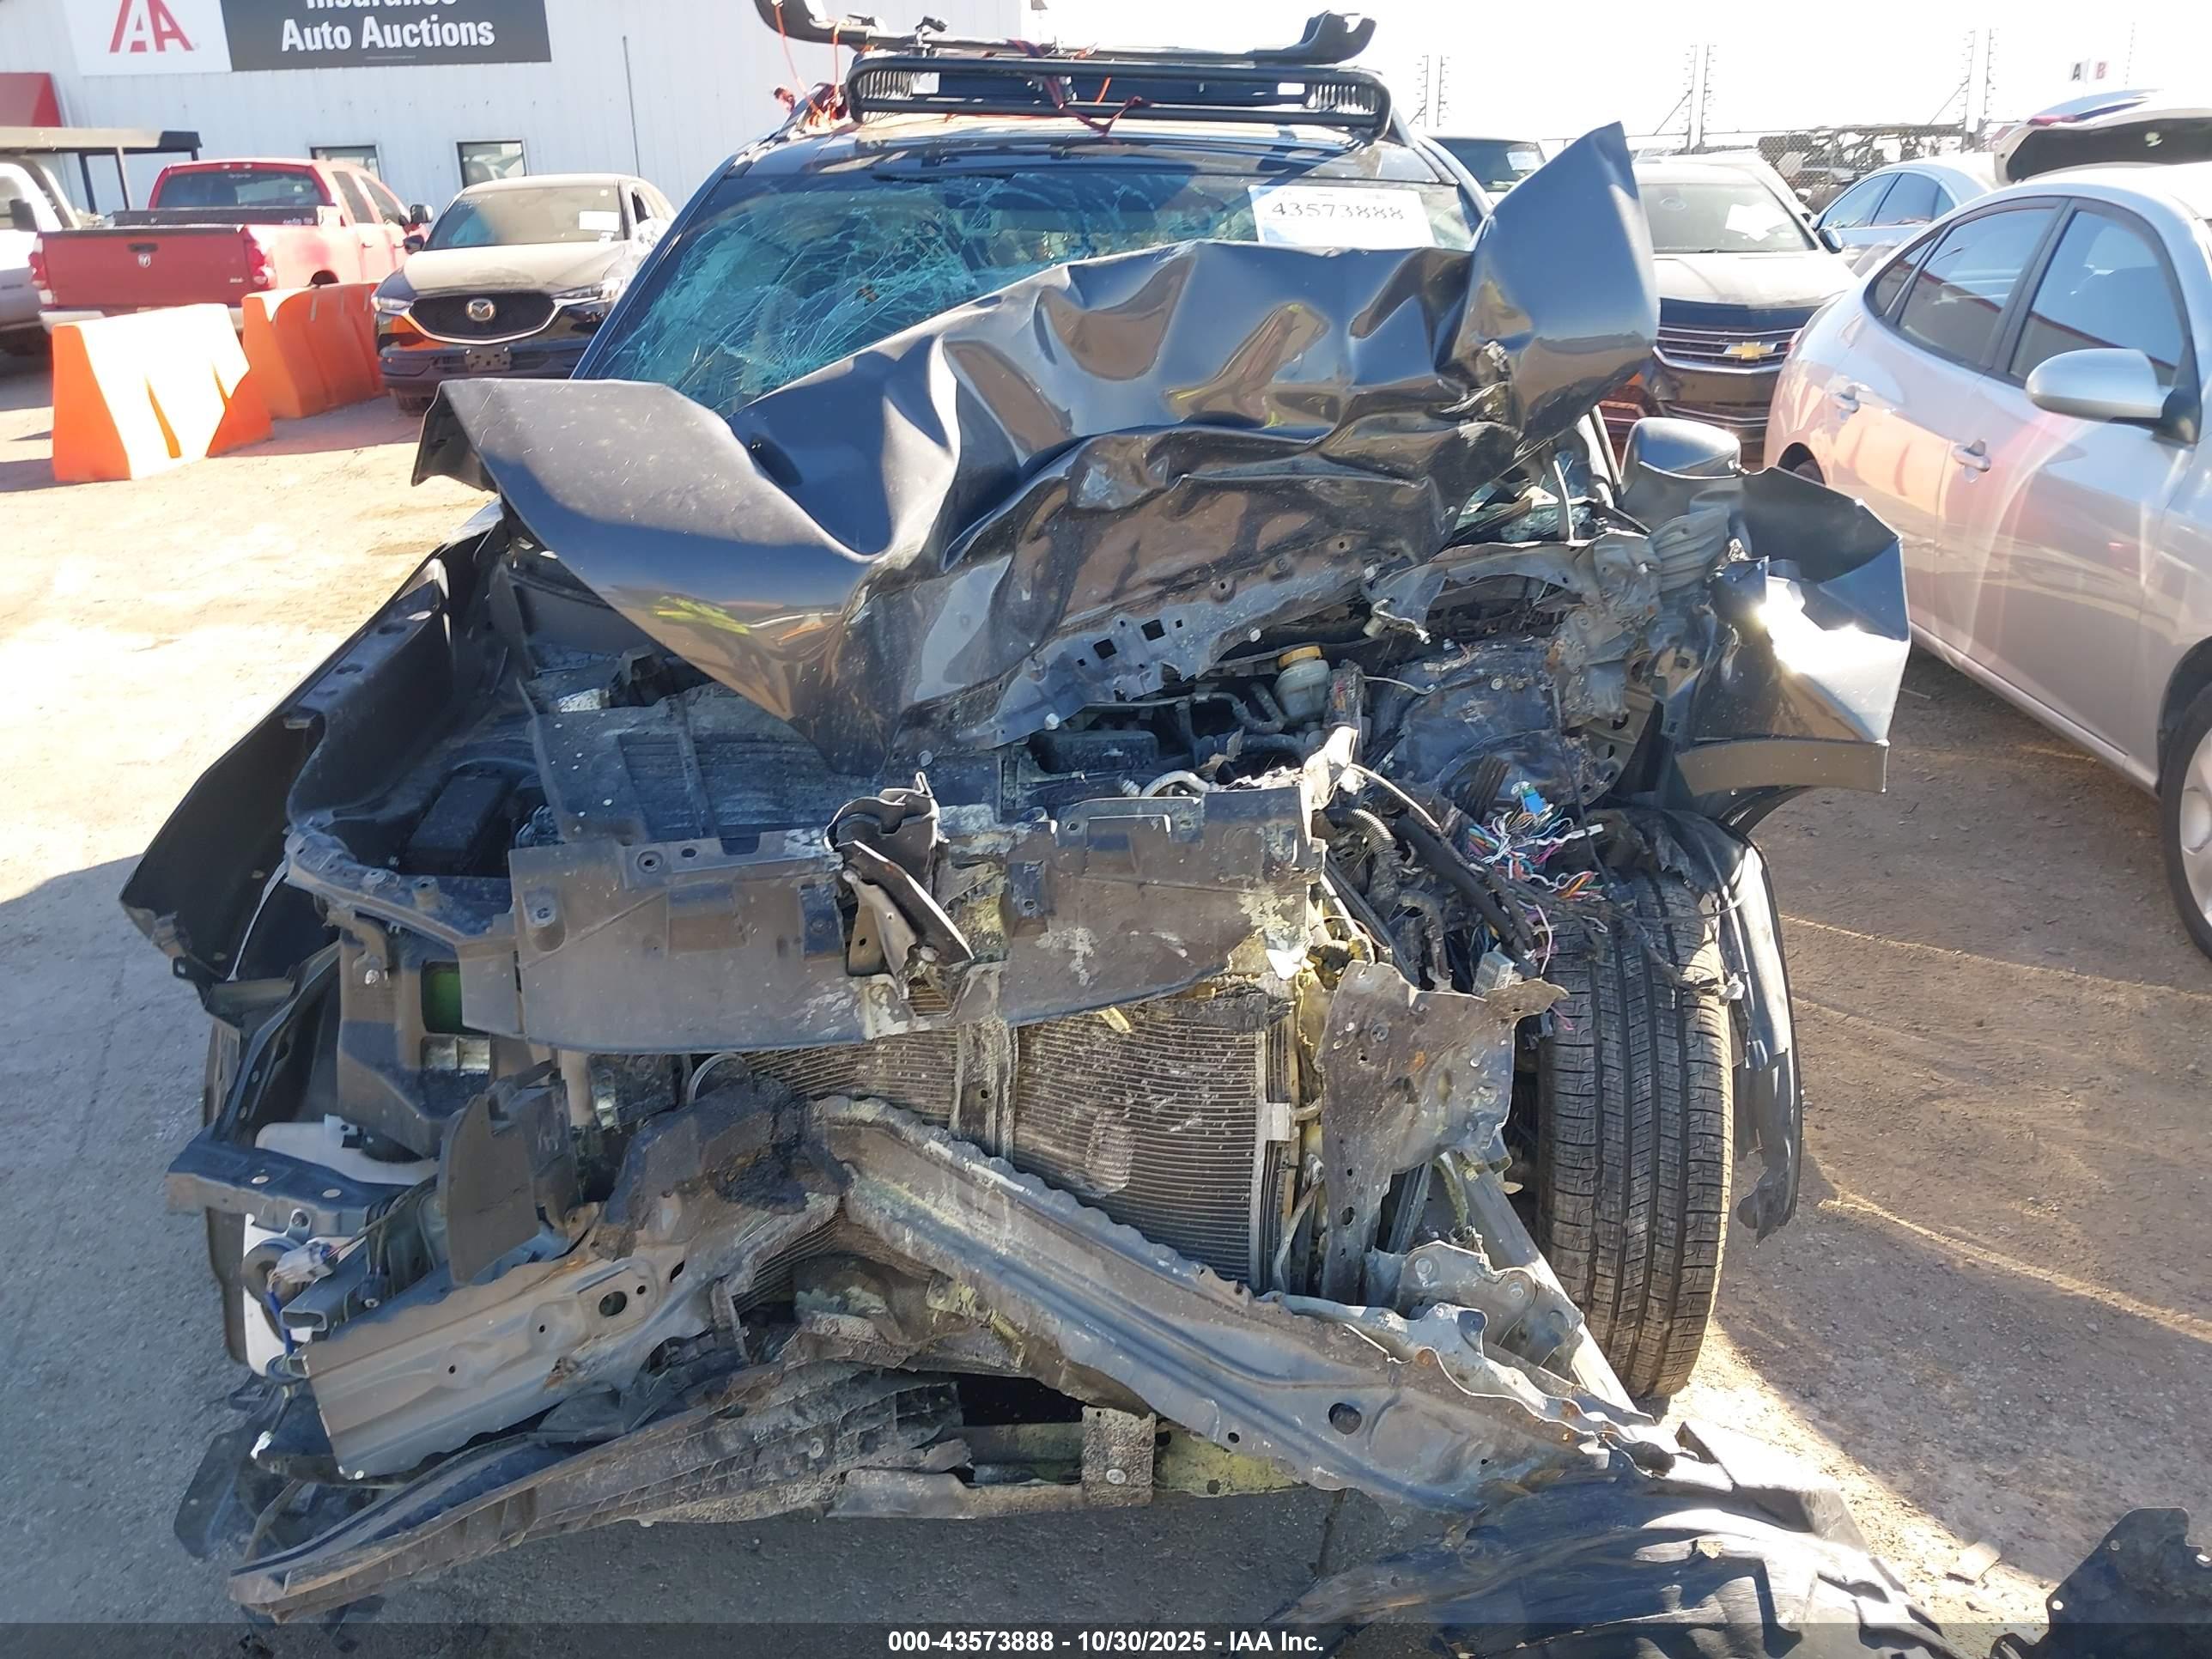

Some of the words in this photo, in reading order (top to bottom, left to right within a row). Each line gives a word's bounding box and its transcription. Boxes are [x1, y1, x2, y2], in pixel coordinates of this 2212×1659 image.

[282, 18, 352, 52] Auto
[361, 14, 495, 49] Auctions
[1272, 202, 1404, 220] 43573888
